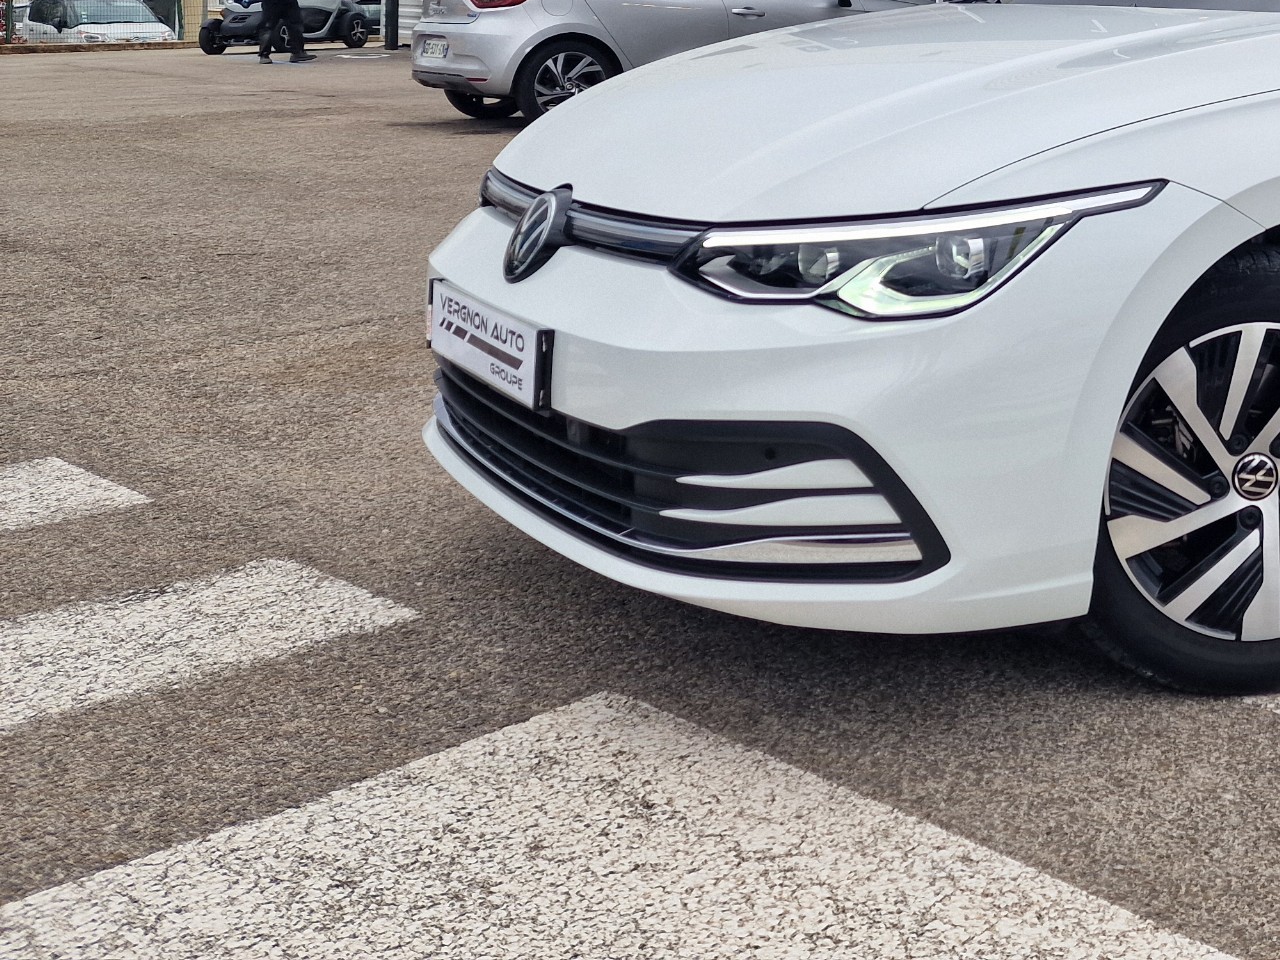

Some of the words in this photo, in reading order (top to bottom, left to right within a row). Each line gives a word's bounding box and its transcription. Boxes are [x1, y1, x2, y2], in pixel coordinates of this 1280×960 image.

[440, 293, 488, 336] VERGNON
[490, 322, 525, 353] AUTO
[489, 362, 523, 391] GROUPE
